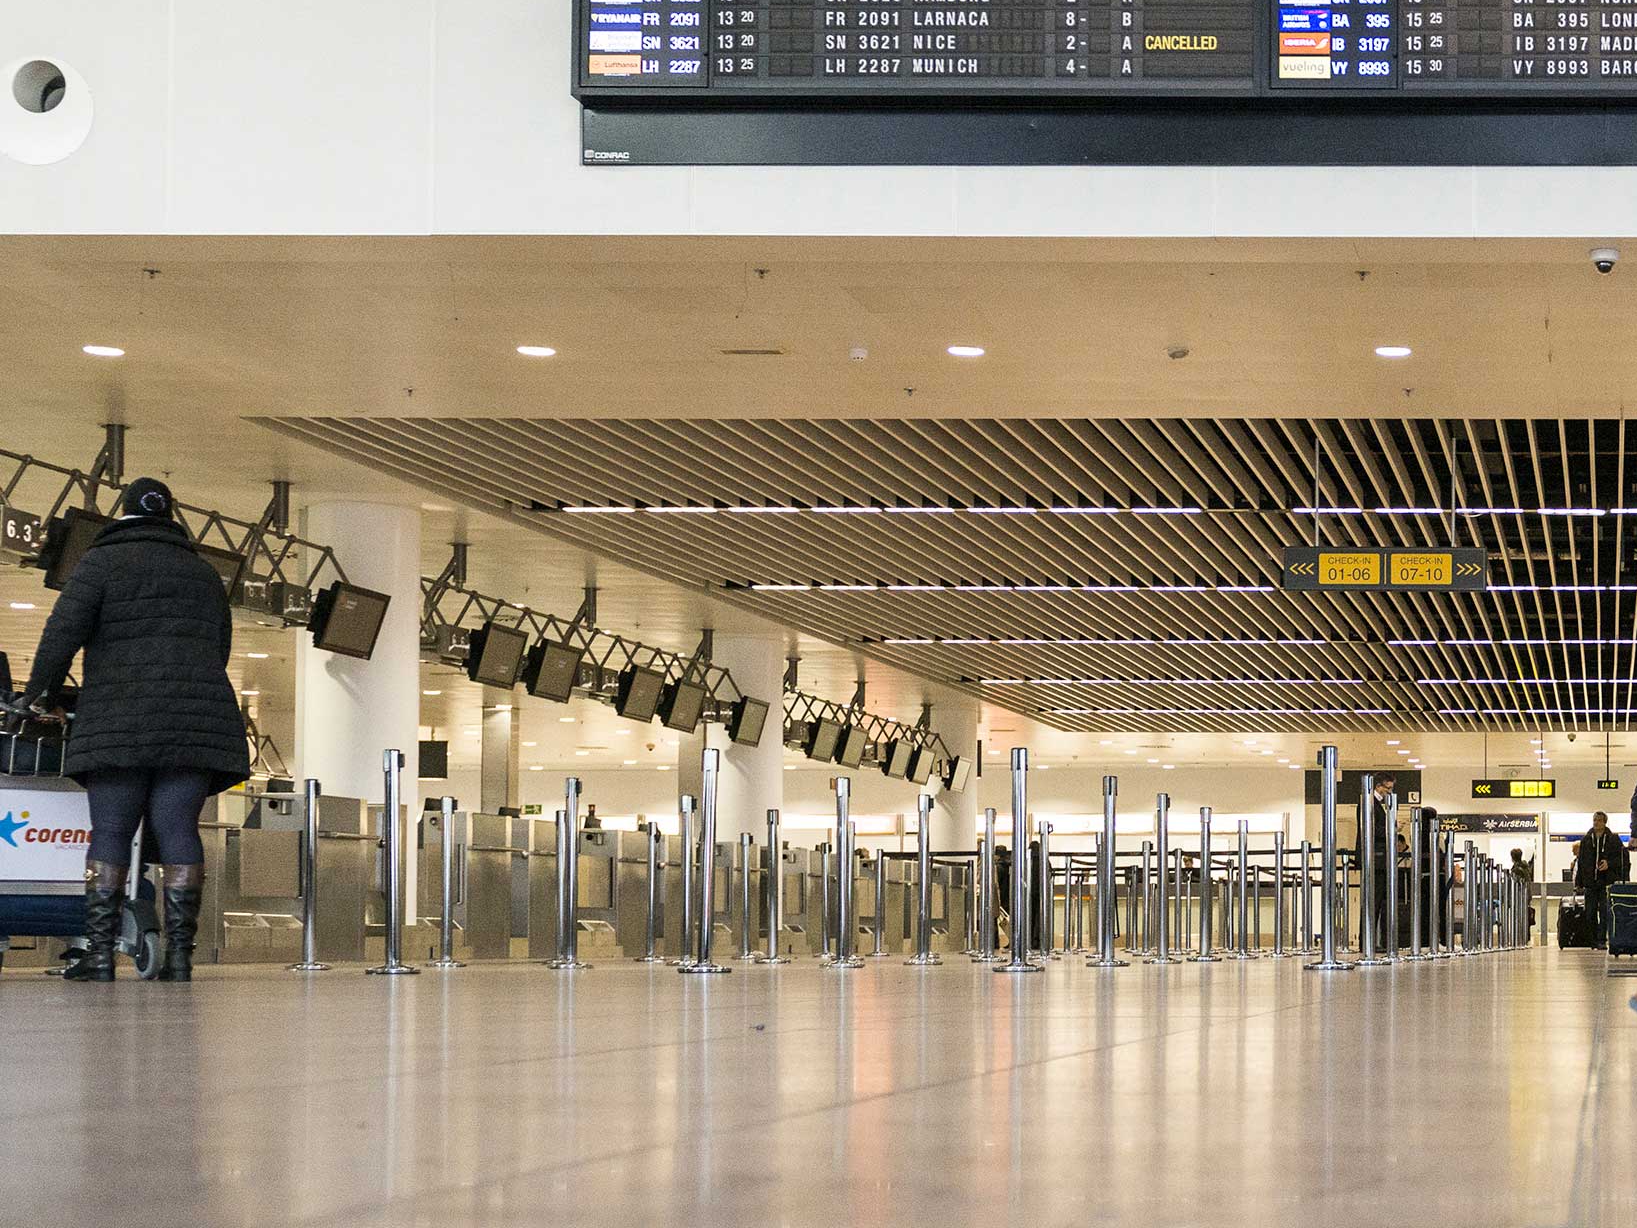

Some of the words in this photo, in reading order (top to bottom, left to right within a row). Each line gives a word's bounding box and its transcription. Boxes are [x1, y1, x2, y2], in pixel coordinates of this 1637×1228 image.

[825, 34, 846, 50] SN
[858, 34, 899, 50] 3621
[913, 34, 956, 50] NICE
[1145, 35, 1218, 50] CANCELLED
[912, 58, 978, 74] MUNICH
[594, 151, 630, 159] CONRAC
[6, 519, 32, 543] 6.3
[1327, 557, 1372, 565] CHECK-IN
[1399, 557, 1444, 565] CHECK-IN
[1327, 568, 1372, 581] 01-06
[1399, 568, 1444, 581] 07-10
